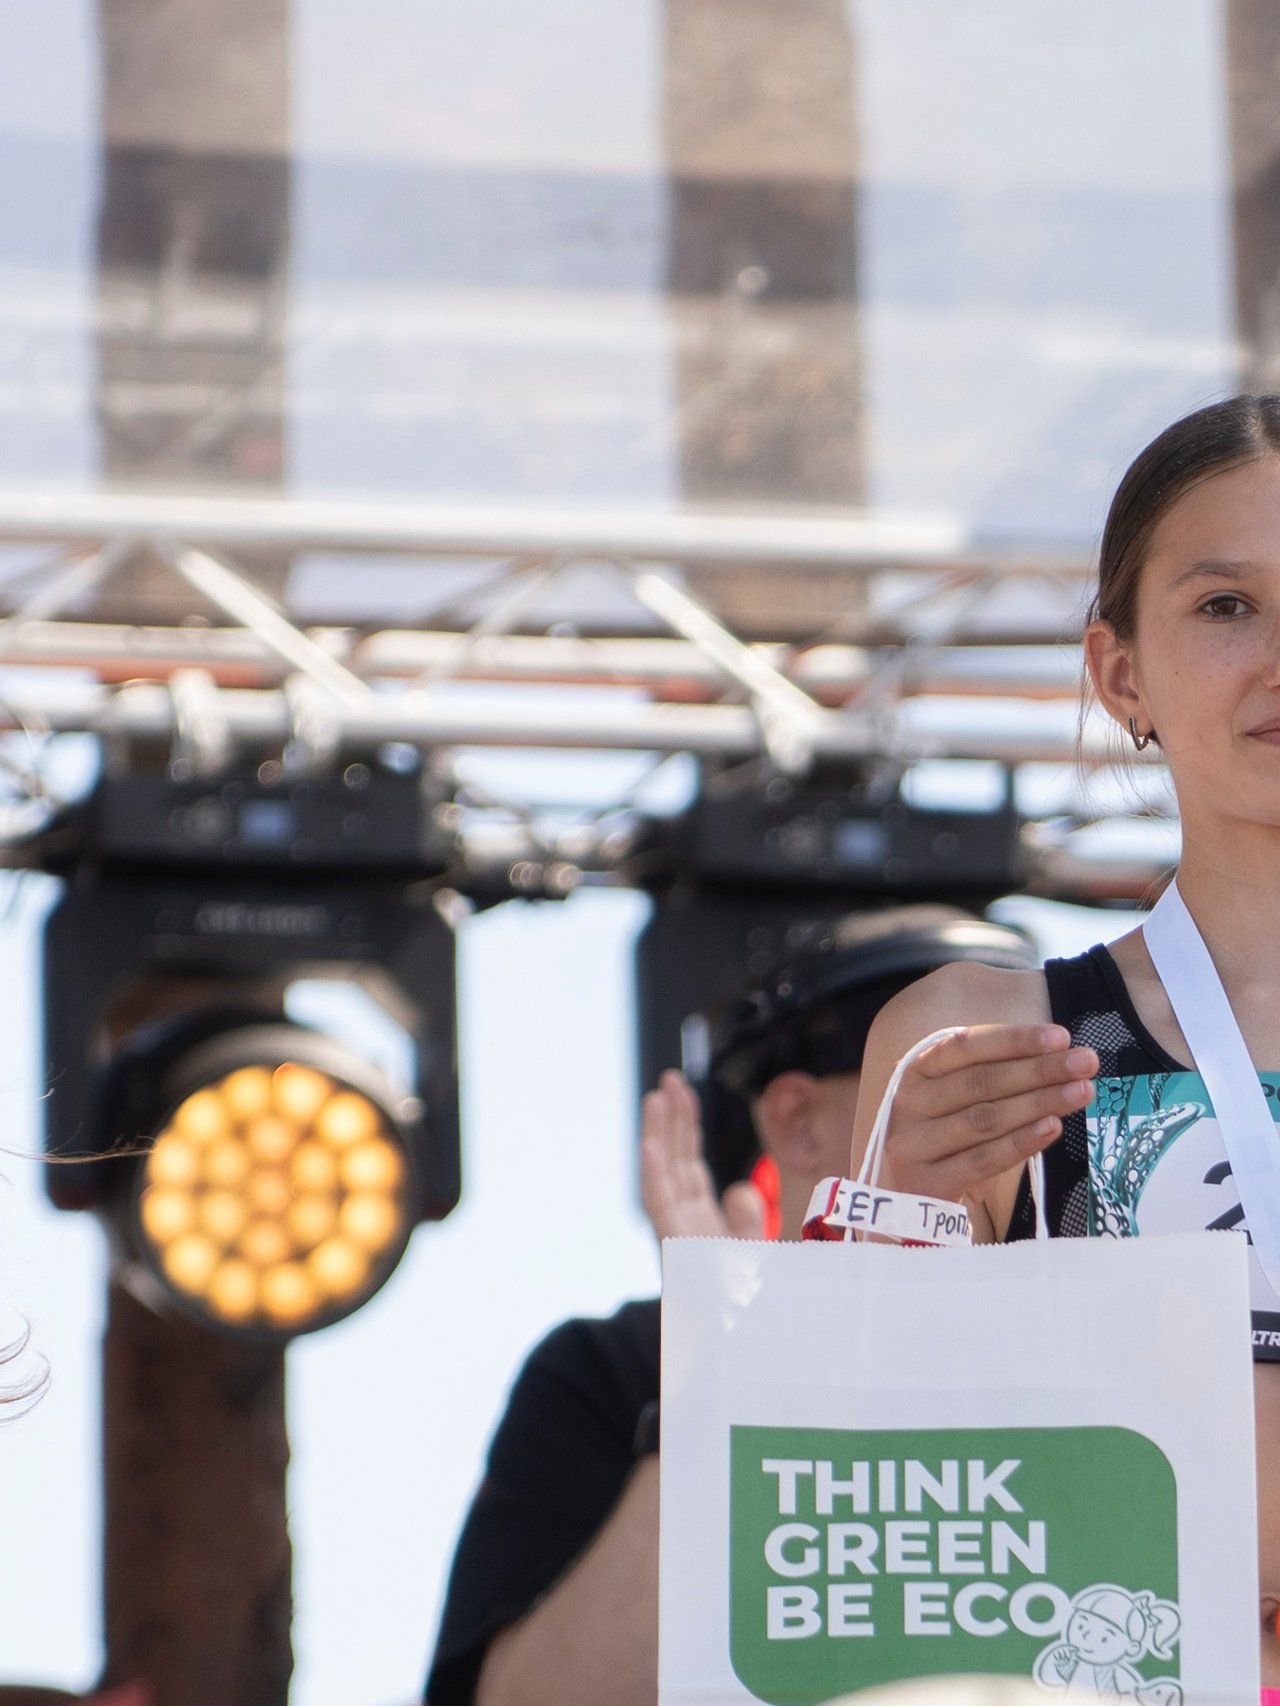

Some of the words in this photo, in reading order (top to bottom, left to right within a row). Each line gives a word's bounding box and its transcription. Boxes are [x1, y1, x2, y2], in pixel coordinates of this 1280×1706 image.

[761, 1458, 1024, 1515] THINK
[764, 1520, 1047, 1578] GREEN
[767, 1583, 874, 1640] BE
[904, 1581, 1071, 1637] ECO
